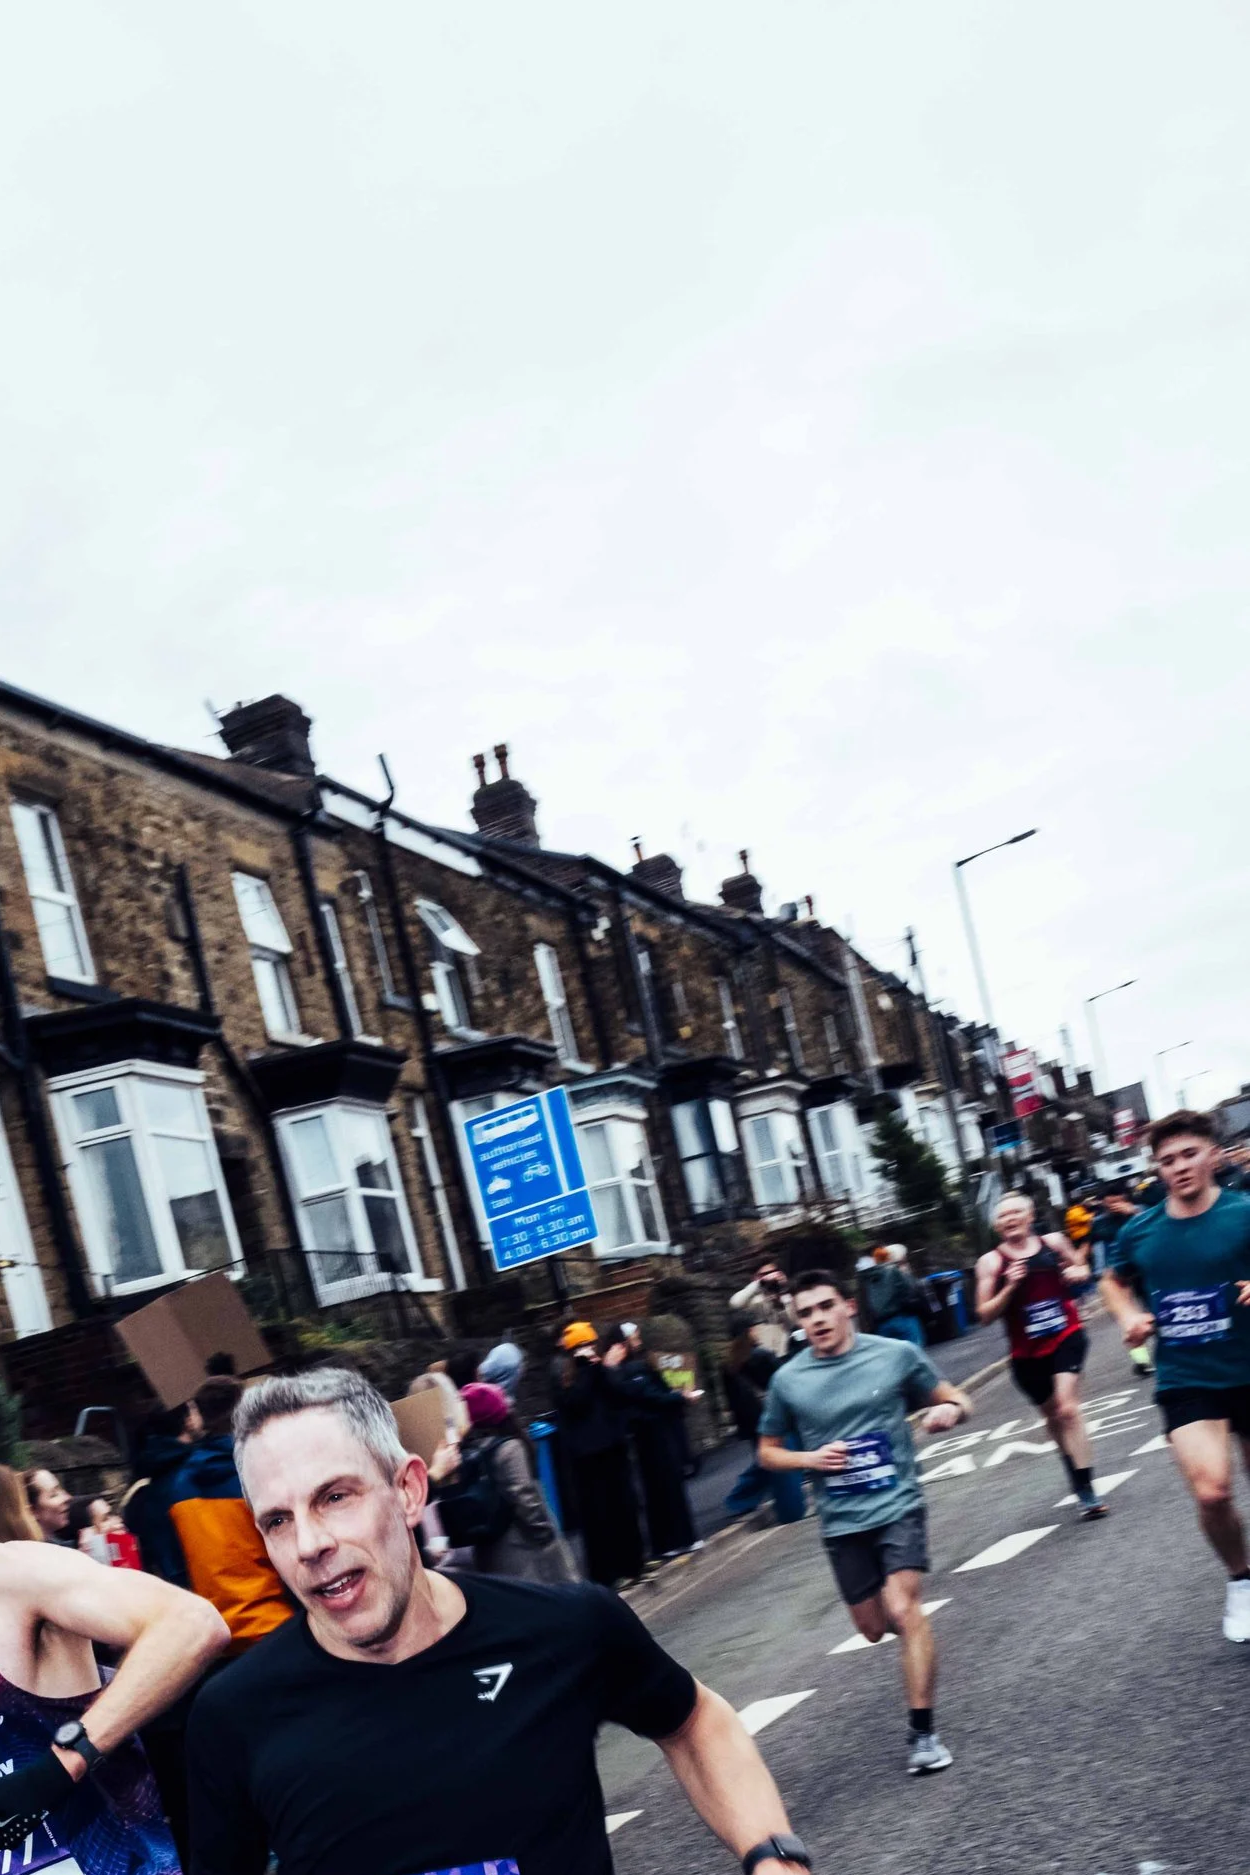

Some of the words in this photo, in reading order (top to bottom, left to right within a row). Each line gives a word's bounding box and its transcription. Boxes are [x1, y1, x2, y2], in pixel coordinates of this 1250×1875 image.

[490, 1149, 538, 1171] vehicles
[566, 1214, 585, 1226] am
[570, 1227, 589, 1240] pm
